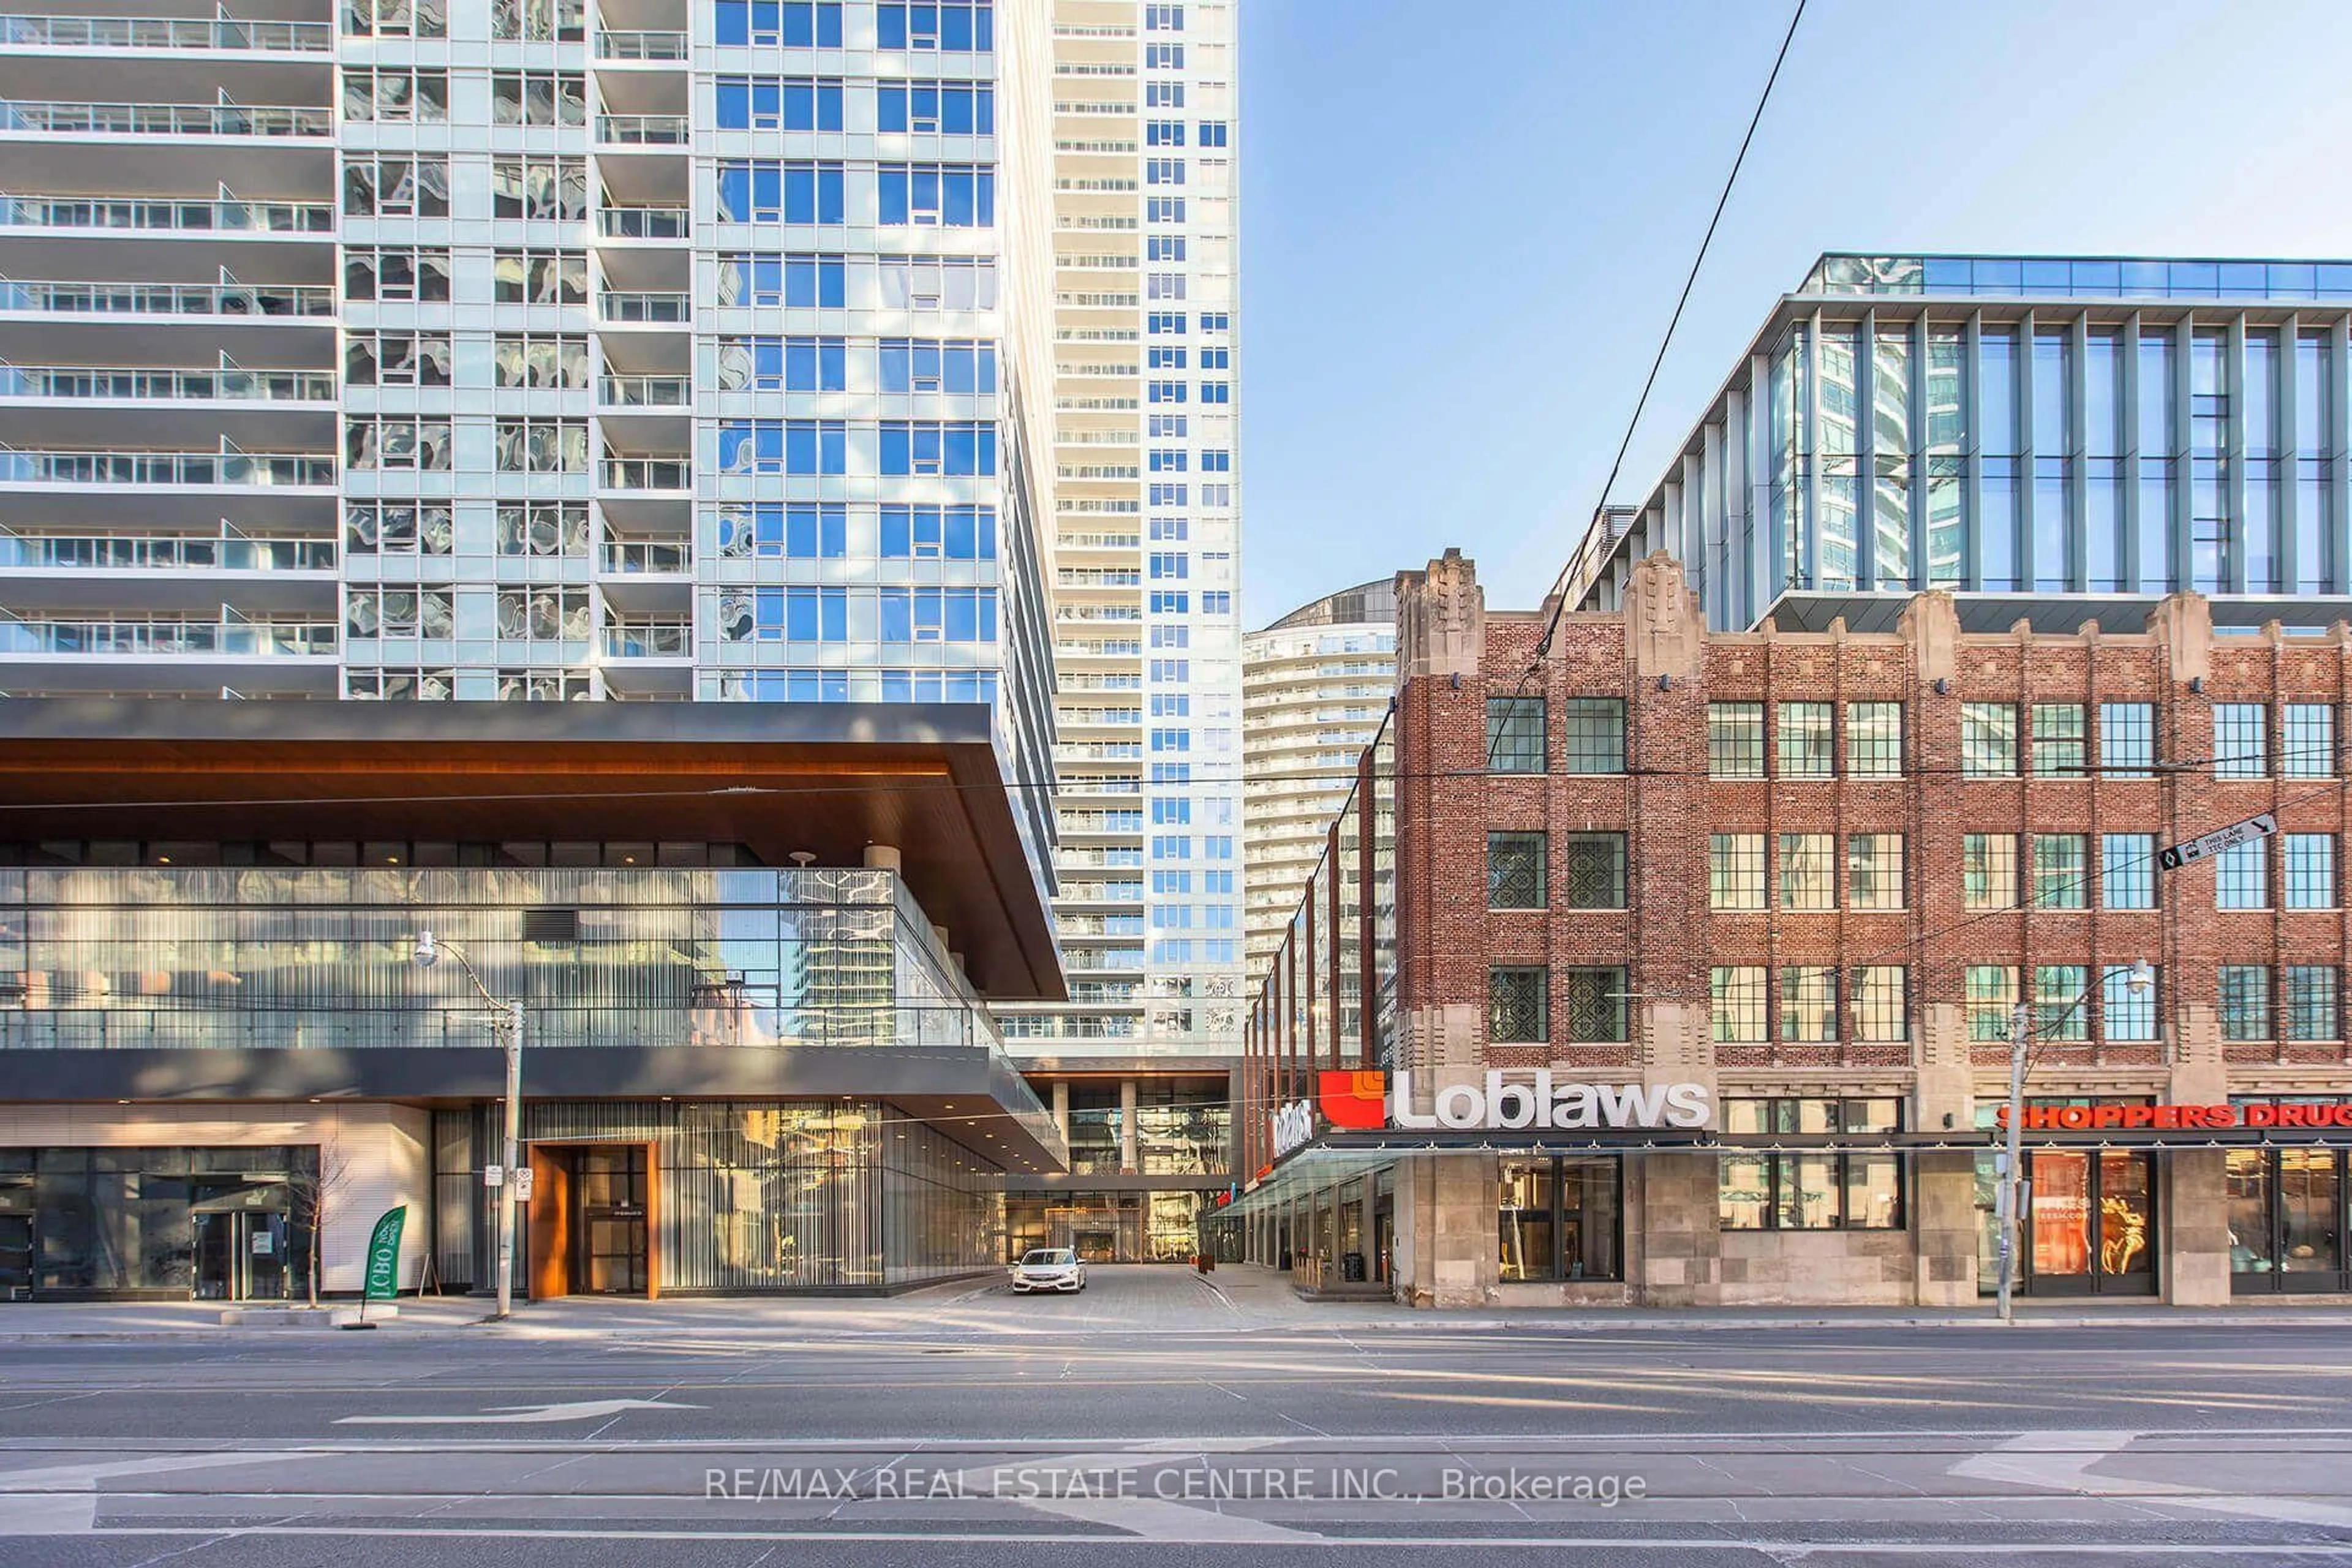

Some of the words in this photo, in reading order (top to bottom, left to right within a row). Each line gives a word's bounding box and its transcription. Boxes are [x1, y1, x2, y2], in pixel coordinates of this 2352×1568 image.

[1393, 1070, 1711, 1129] Loblaws
[1995, 1104, 2236, 1130] SHOPPERS
[371, 1248, 393, 1296] LCBO
